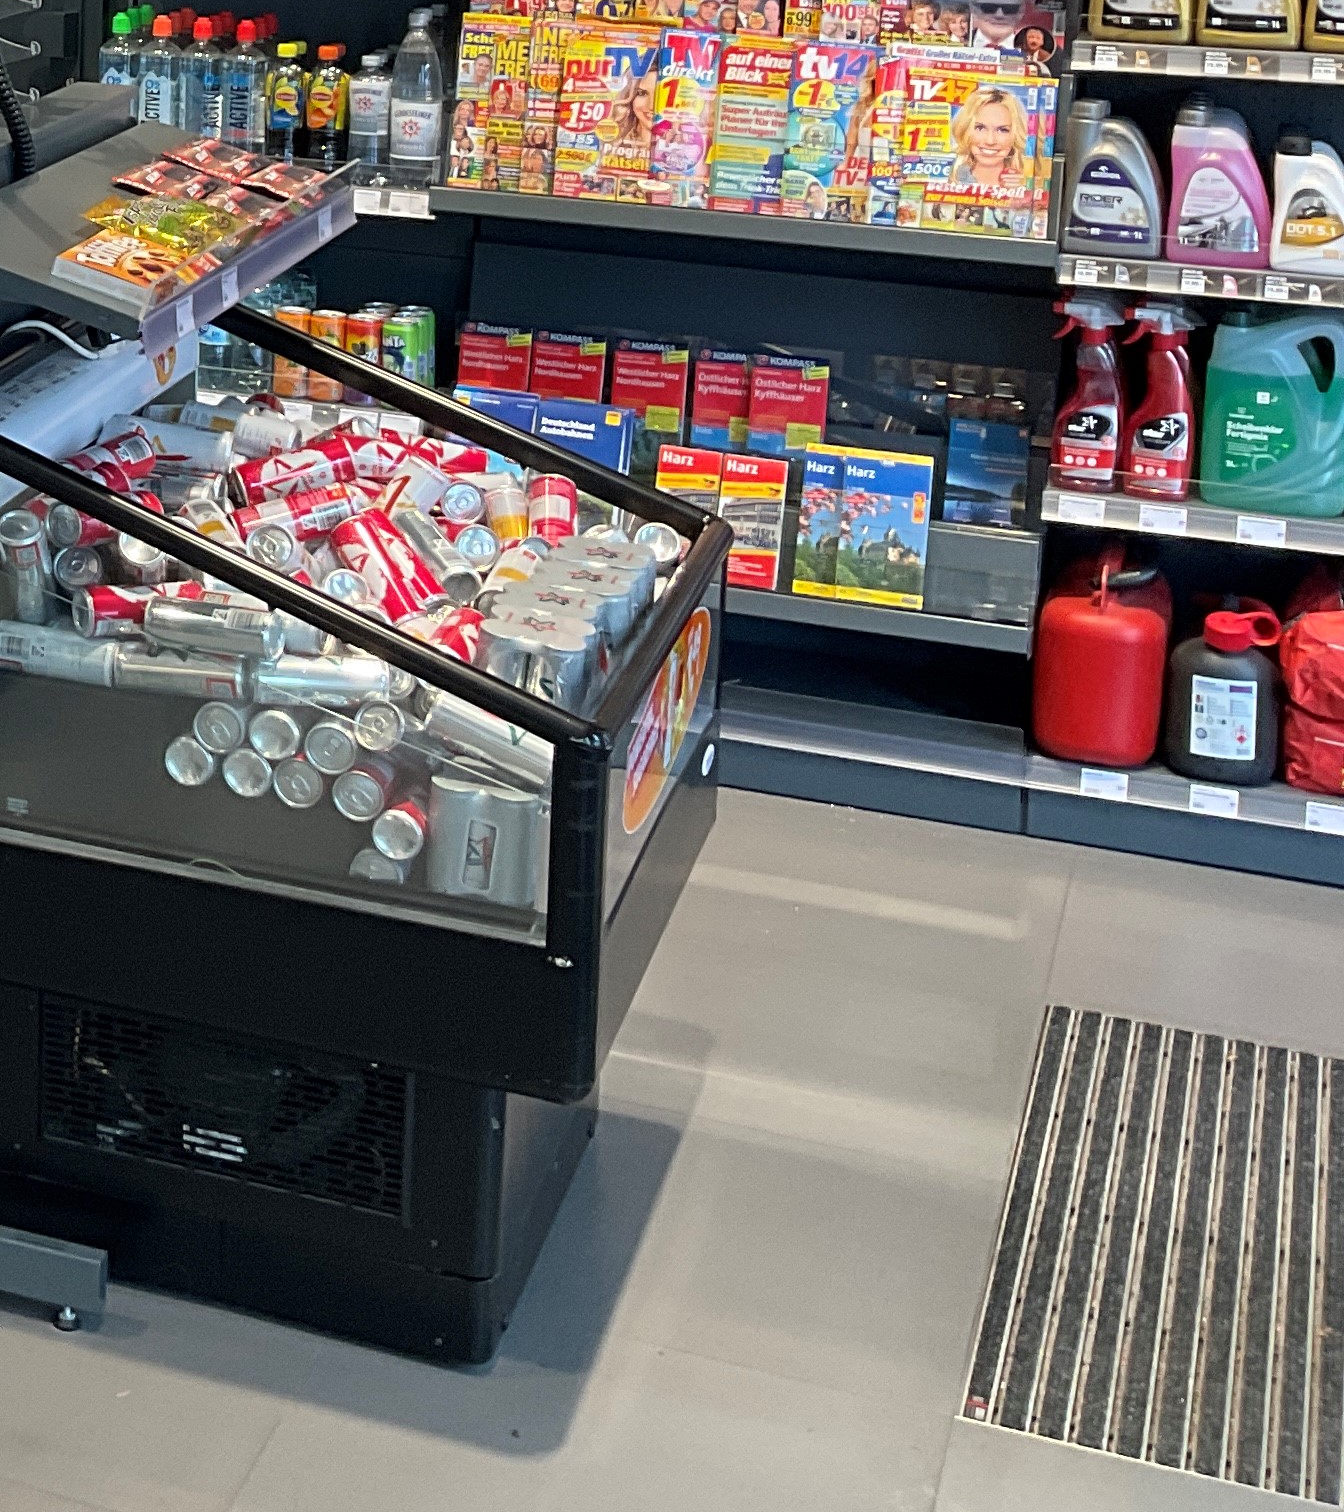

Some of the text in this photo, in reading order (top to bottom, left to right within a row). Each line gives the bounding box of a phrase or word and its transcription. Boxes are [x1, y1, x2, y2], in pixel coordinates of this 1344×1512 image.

[725, 51, 752, 67] auf
[662, 62, 715, 80] direkt
[724, 67, 764, 83] Blick
[230, 86, 249, 130] ACTIVE
[1079, 193, 1124, 206] RIDER
[476, 322, 520, 336] KOMPASS
[550, 332, 594, 345] KOMPASS
[631, 341, 676, 352] KOMPASS
[577, 363, 598, 373] Harz
[769, 356, 816, 369] KOMPASS
[755, 376, 822, 393] Östlicher Harz
[754, 389, 805, 403] Kyffhäuser
[541, 416, 596, 432] Deutschland
[540, 425, 594, 441] Autobahnen
[662, 450, 694, 467] Harz
[726, 458, 759, 475] Harz
[806, 460, 835, 475] Harz
[847, 464, 876, 480] Harz
